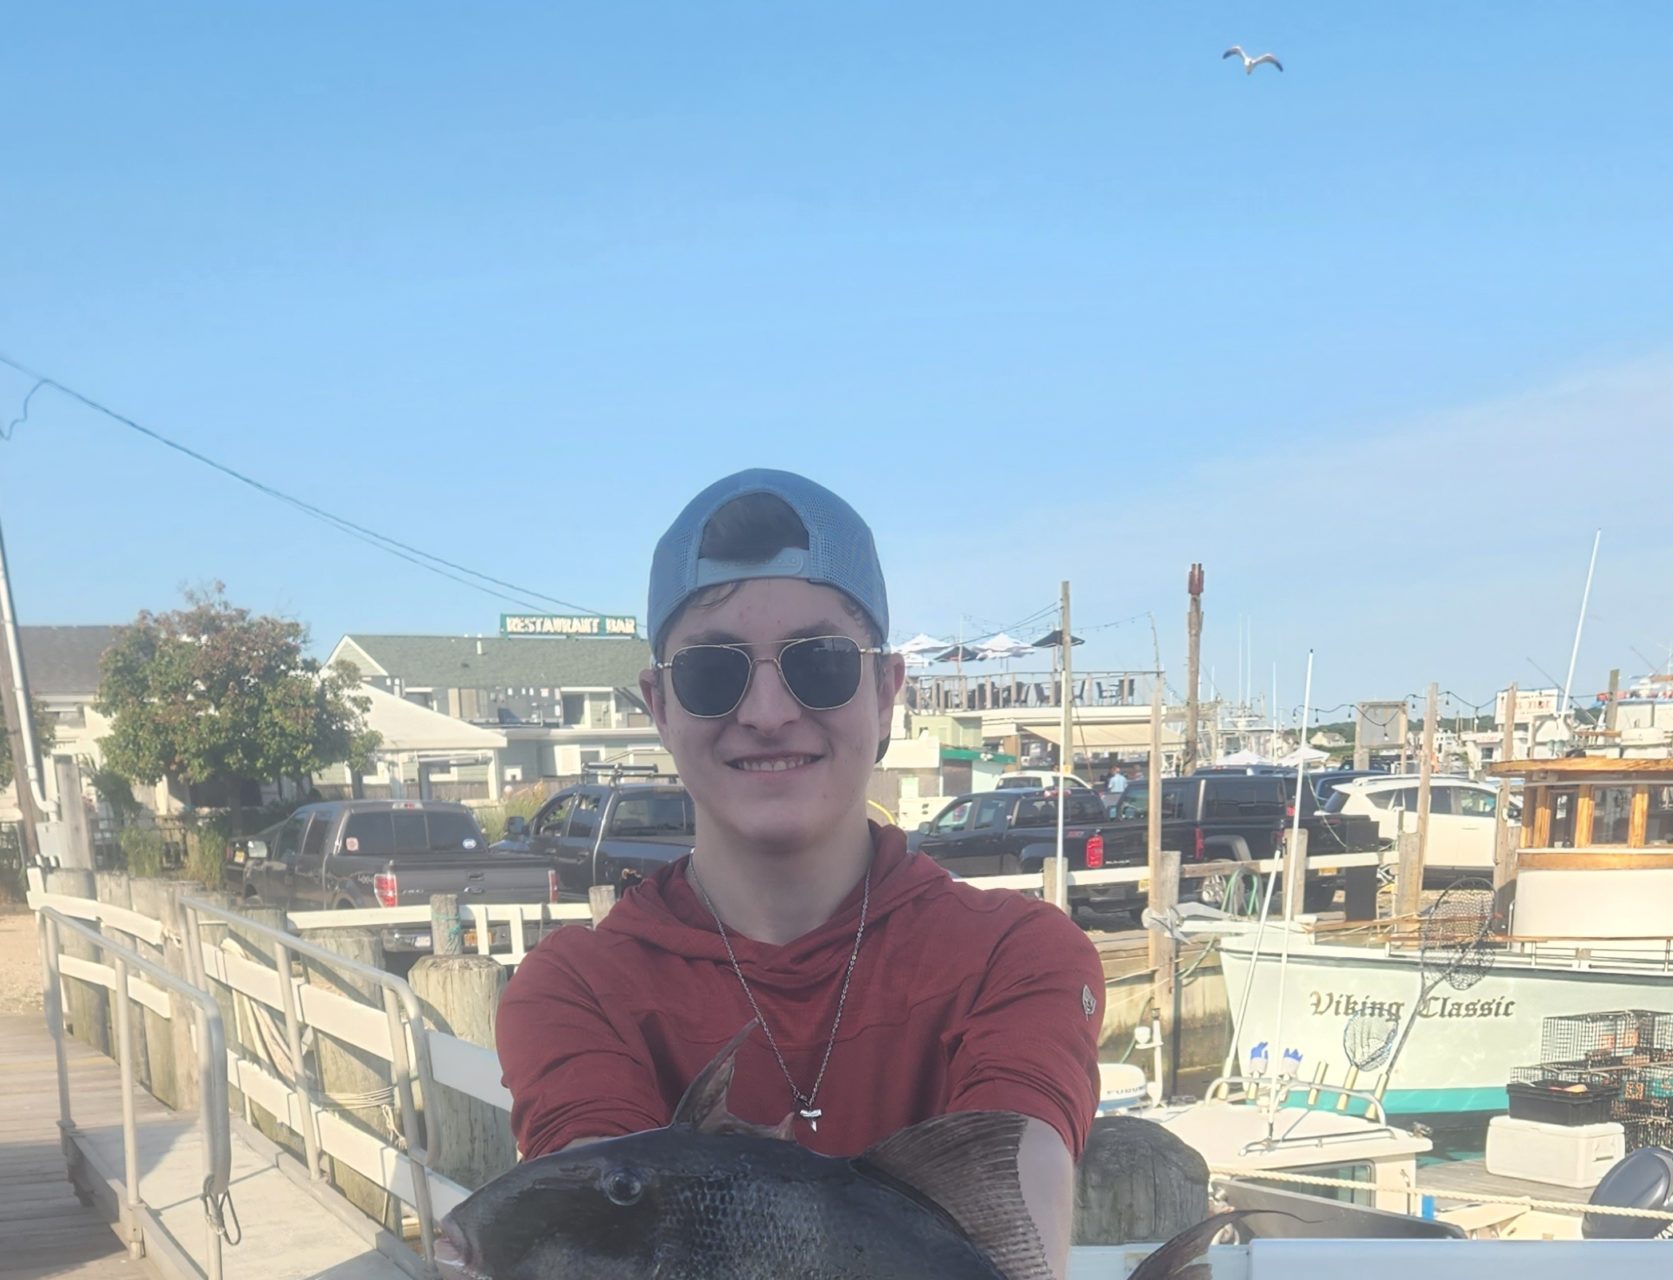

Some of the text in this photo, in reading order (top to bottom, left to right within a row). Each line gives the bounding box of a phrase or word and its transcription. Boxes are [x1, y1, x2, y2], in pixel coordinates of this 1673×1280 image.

[506, 616, 636, 633] RESTAURANT BAR
[1310, 991, 1516, 1022] Viking Classic
